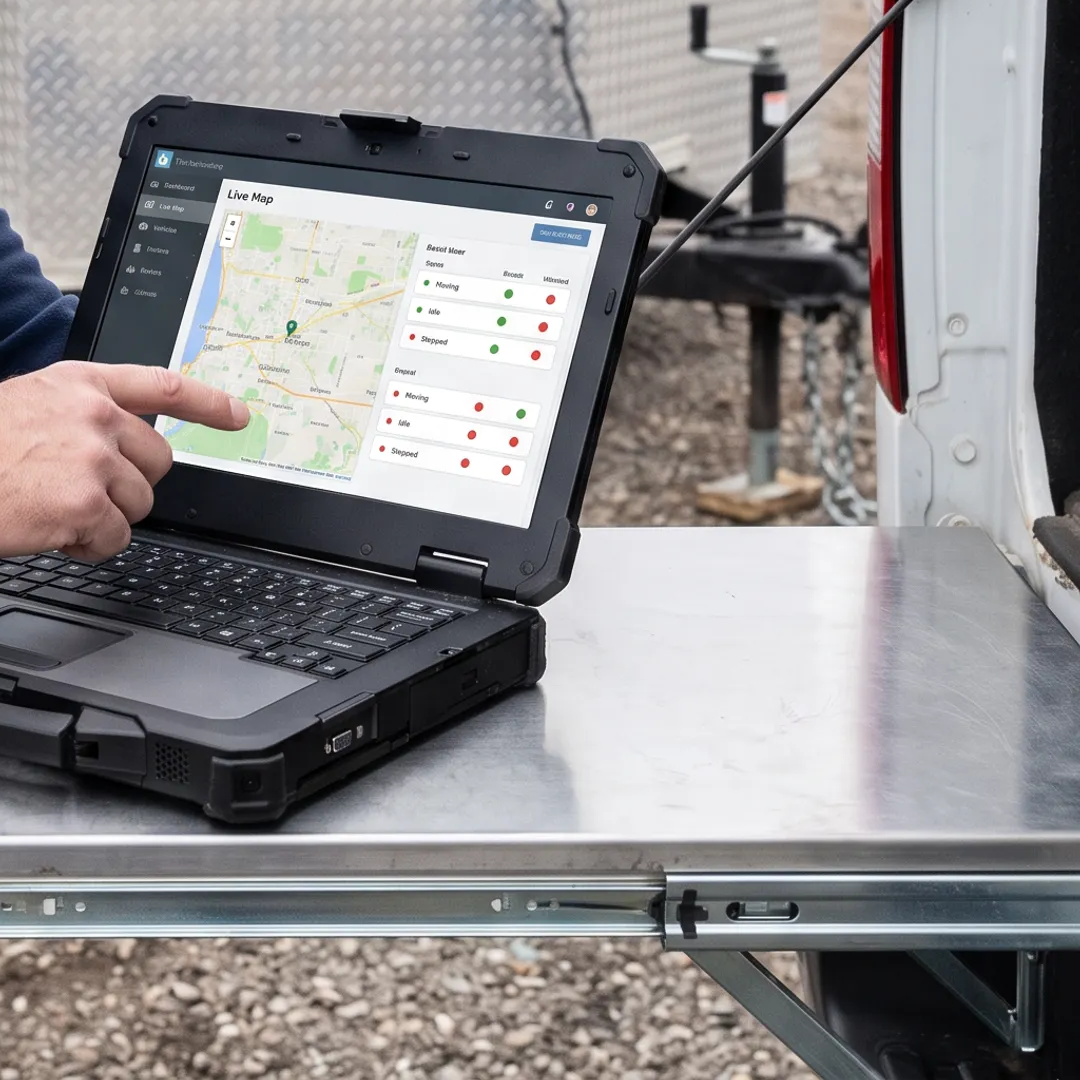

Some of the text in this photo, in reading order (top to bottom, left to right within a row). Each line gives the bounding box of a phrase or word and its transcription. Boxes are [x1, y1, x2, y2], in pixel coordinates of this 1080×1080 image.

[227, 188, 274, 206] Live Map
[435, 281, 460, 292] Moving
[404, 391, 430, 403] Moving
